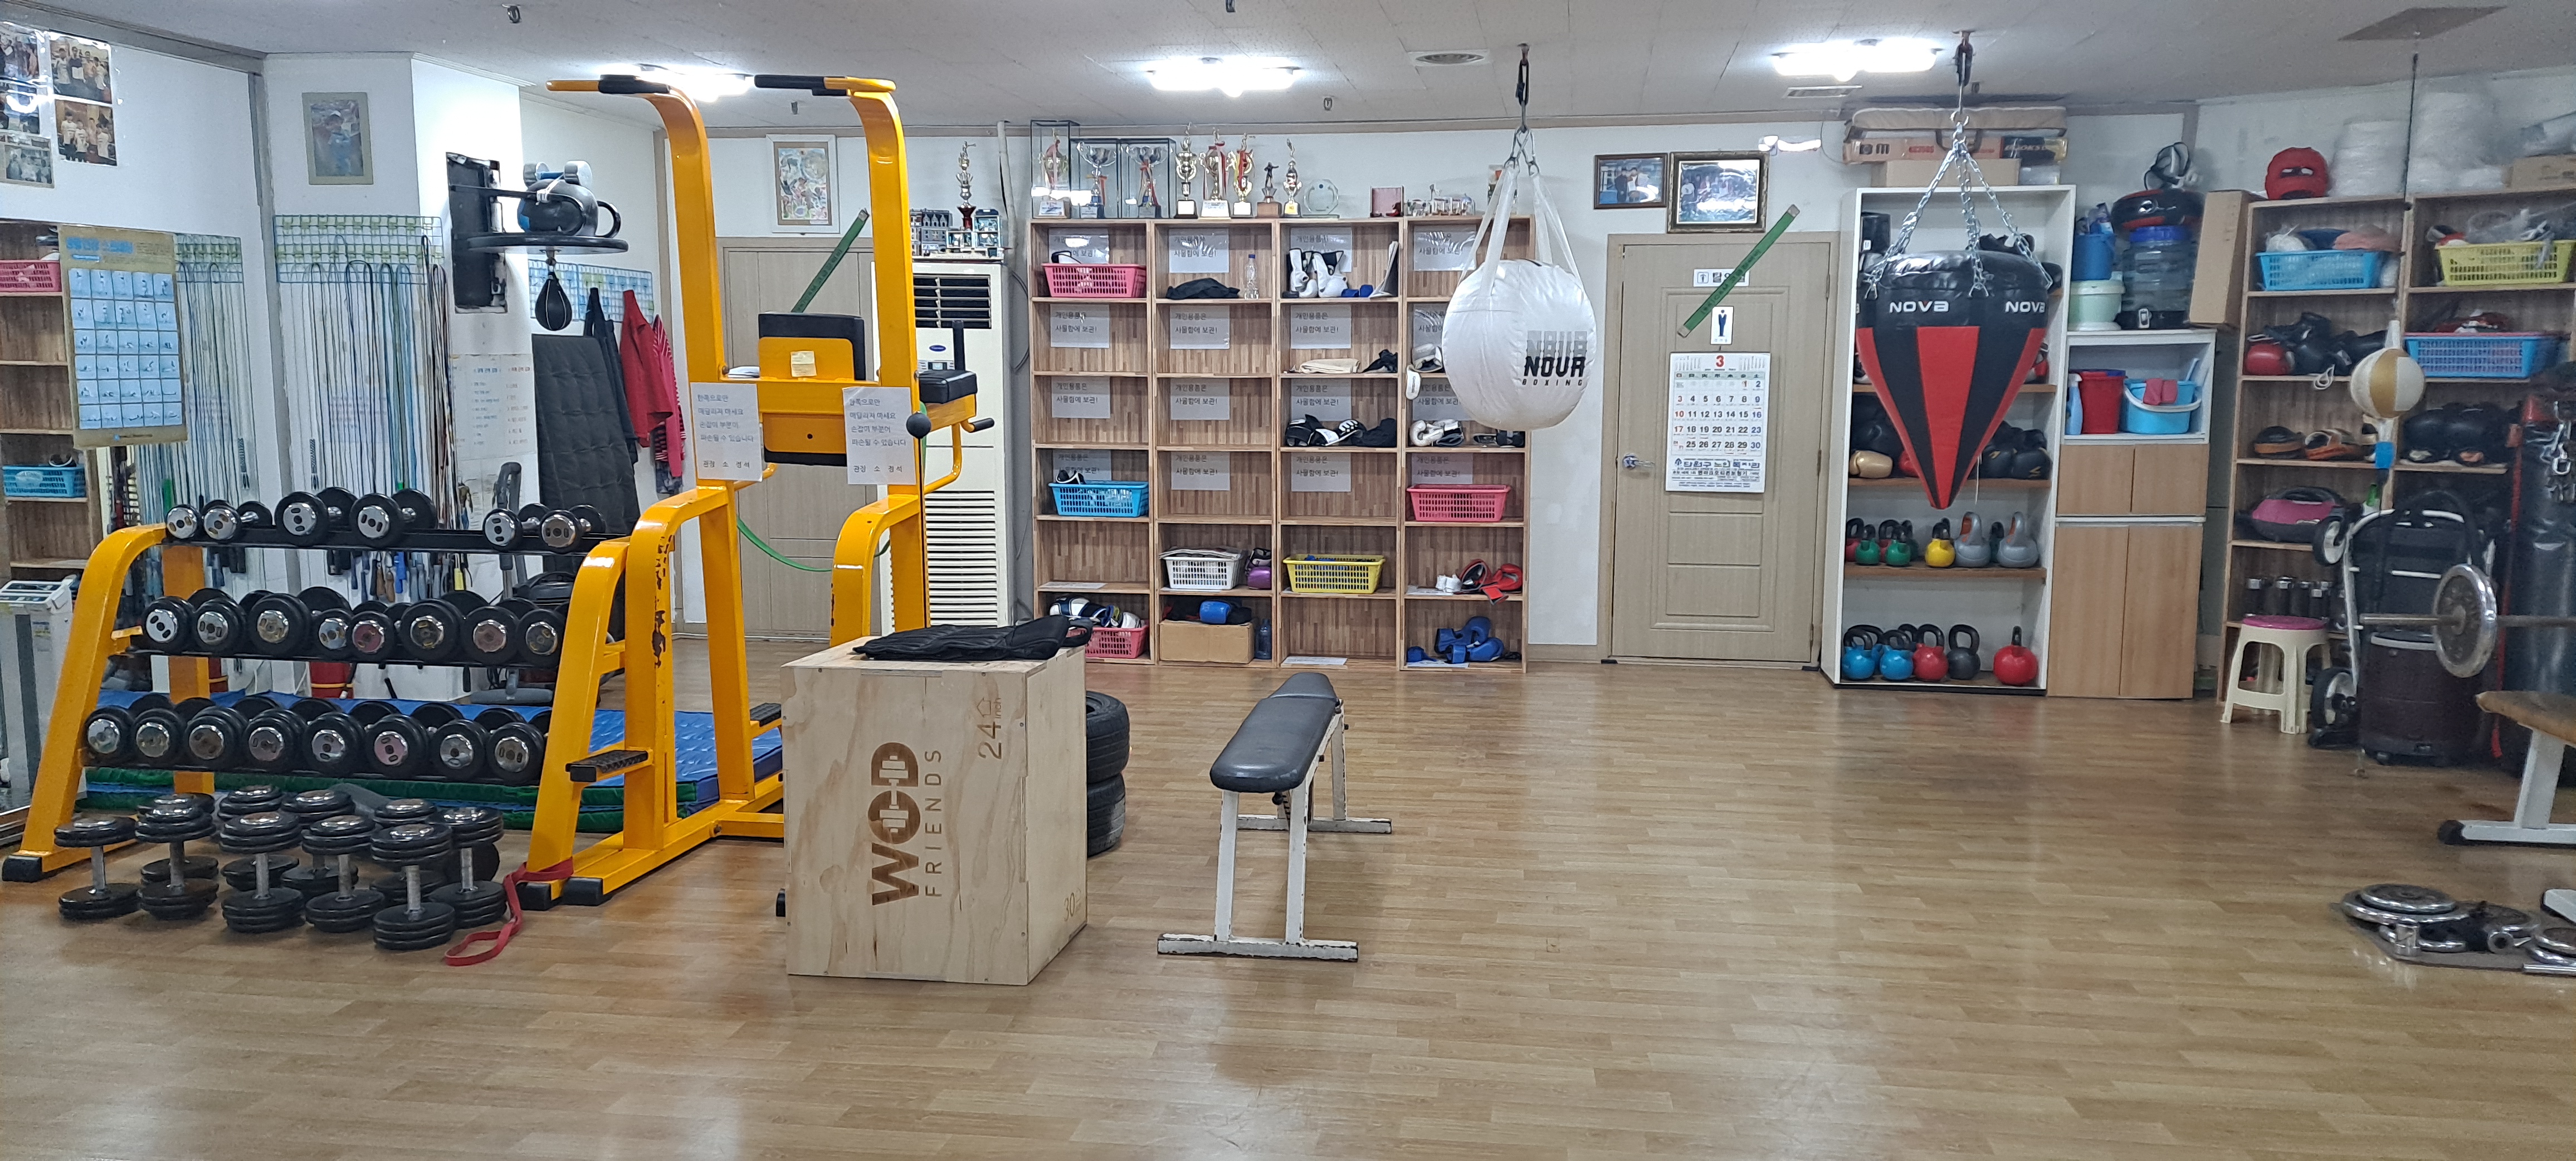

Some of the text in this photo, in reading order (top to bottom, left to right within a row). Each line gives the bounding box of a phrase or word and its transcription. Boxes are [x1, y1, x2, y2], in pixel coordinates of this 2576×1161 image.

[1716, 355, 1725, 368] 3
[977, 697, 1002, 760] 24 inch
[924, 750, 942, 897] FRIENDS
[1063, 892, 1075, 923] 30
